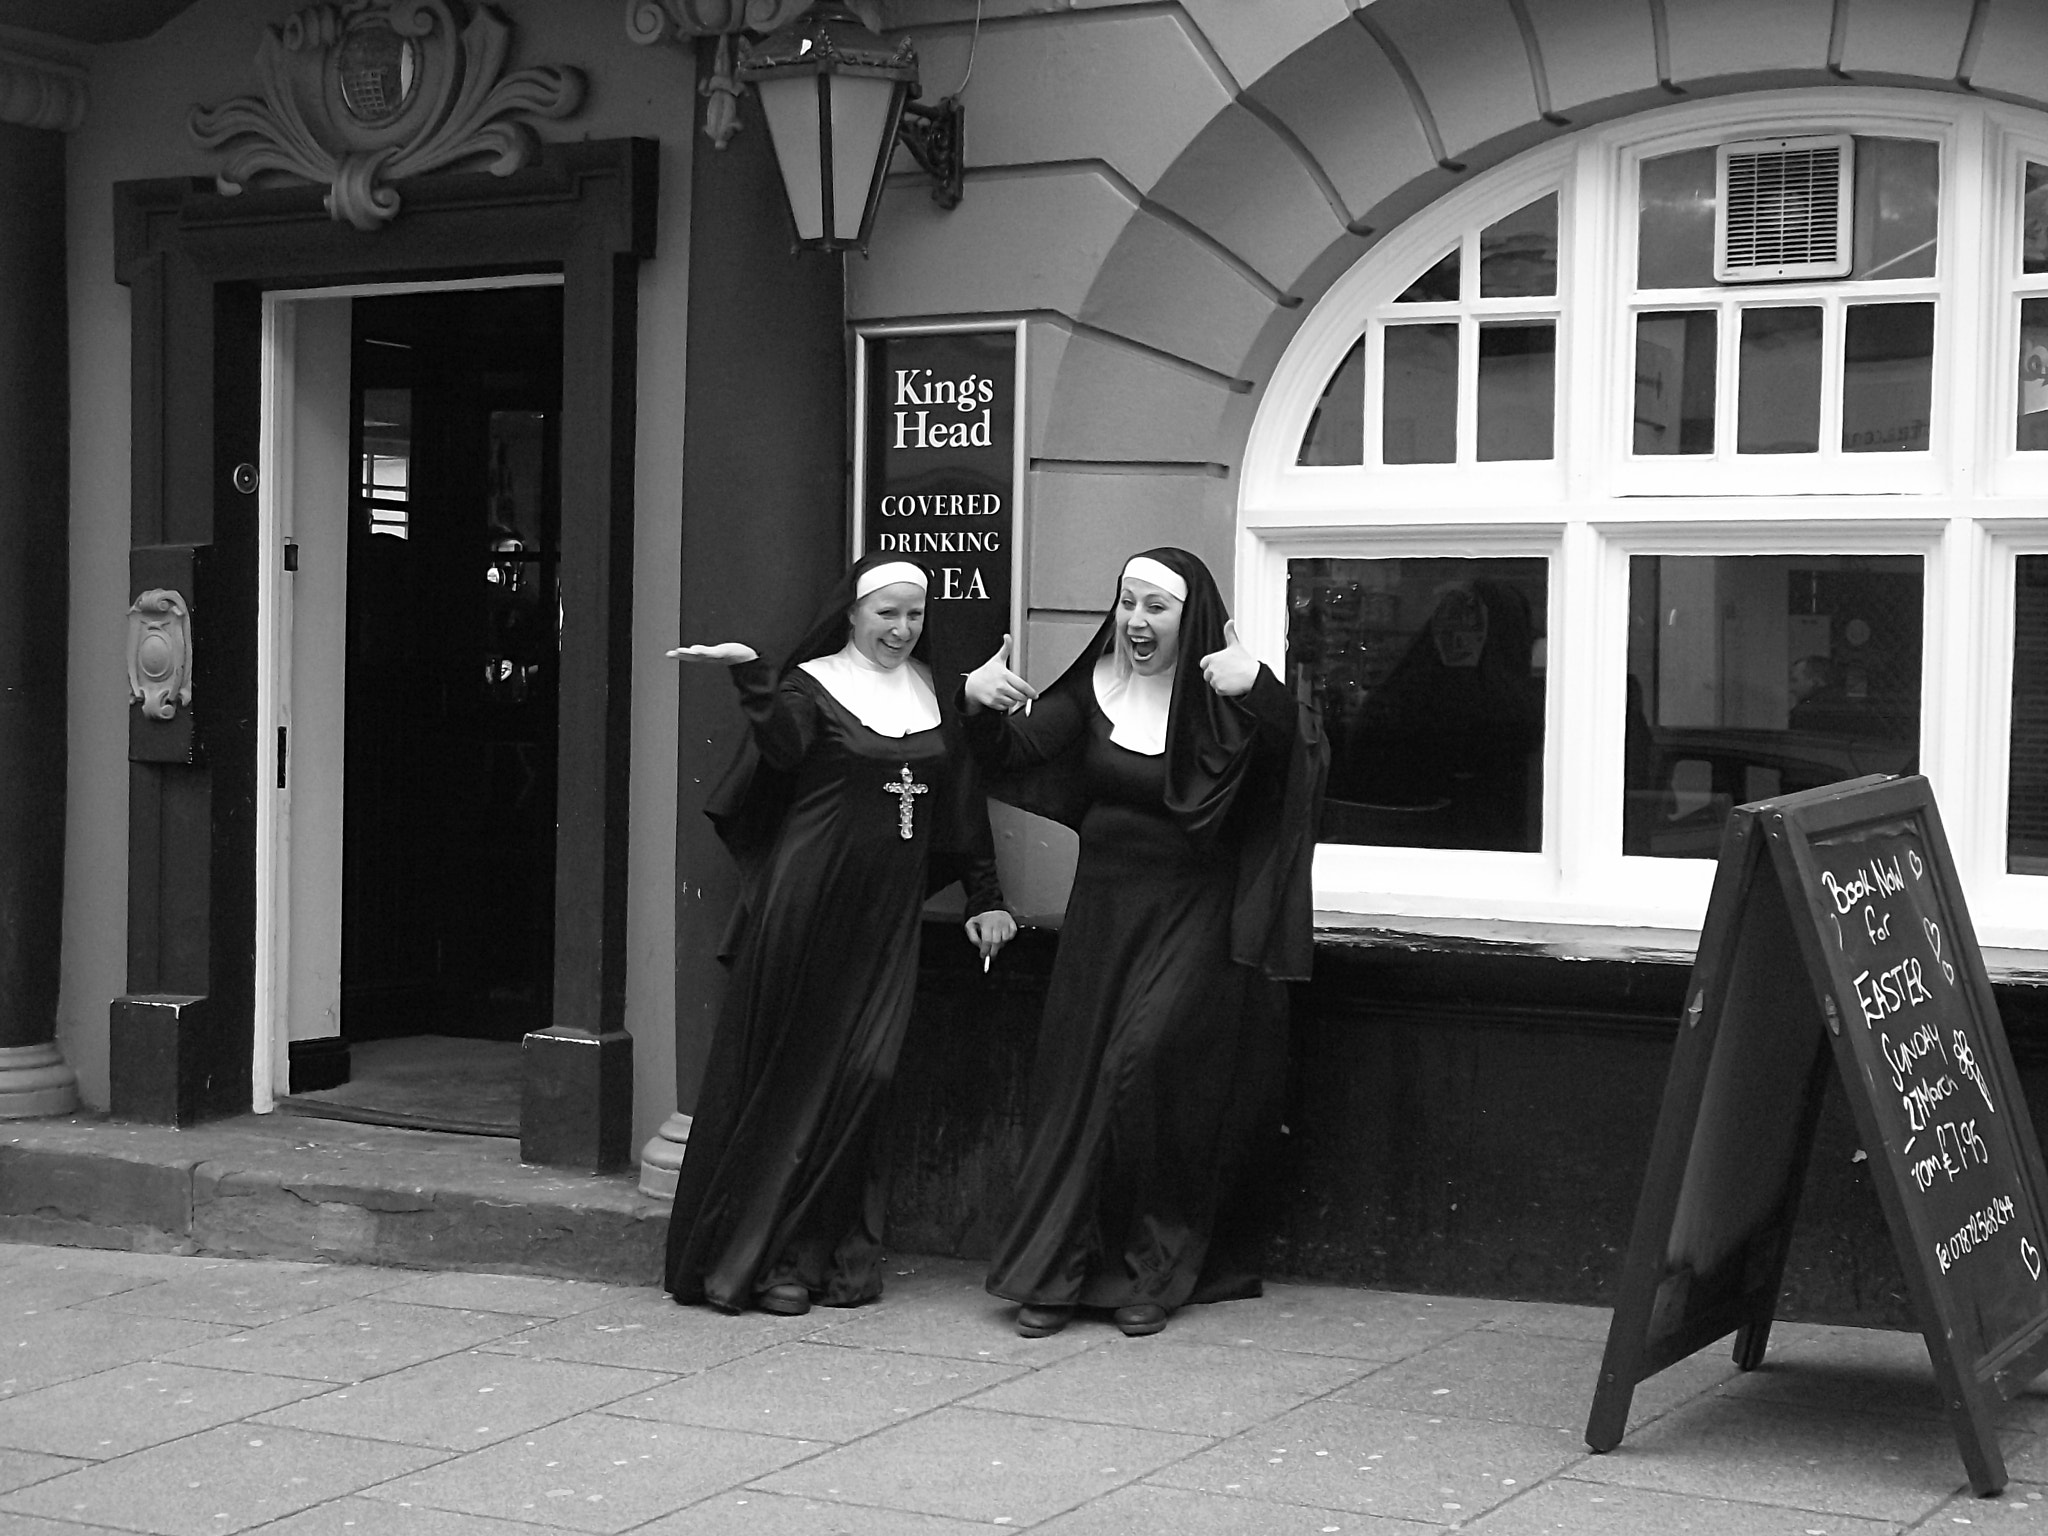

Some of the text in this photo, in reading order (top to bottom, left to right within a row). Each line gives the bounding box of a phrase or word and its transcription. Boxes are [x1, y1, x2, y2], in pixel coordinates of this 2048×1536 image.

[894, 369, 994, 412] Kings
[893, 408, 992, 449] Head
[881, 494, 1001, 517] COVERED
[880, 531, 1000, 553] DRINKING
[930, 567, 990, 600] EA
[1853, 957, 1933, 1030] EASTER
